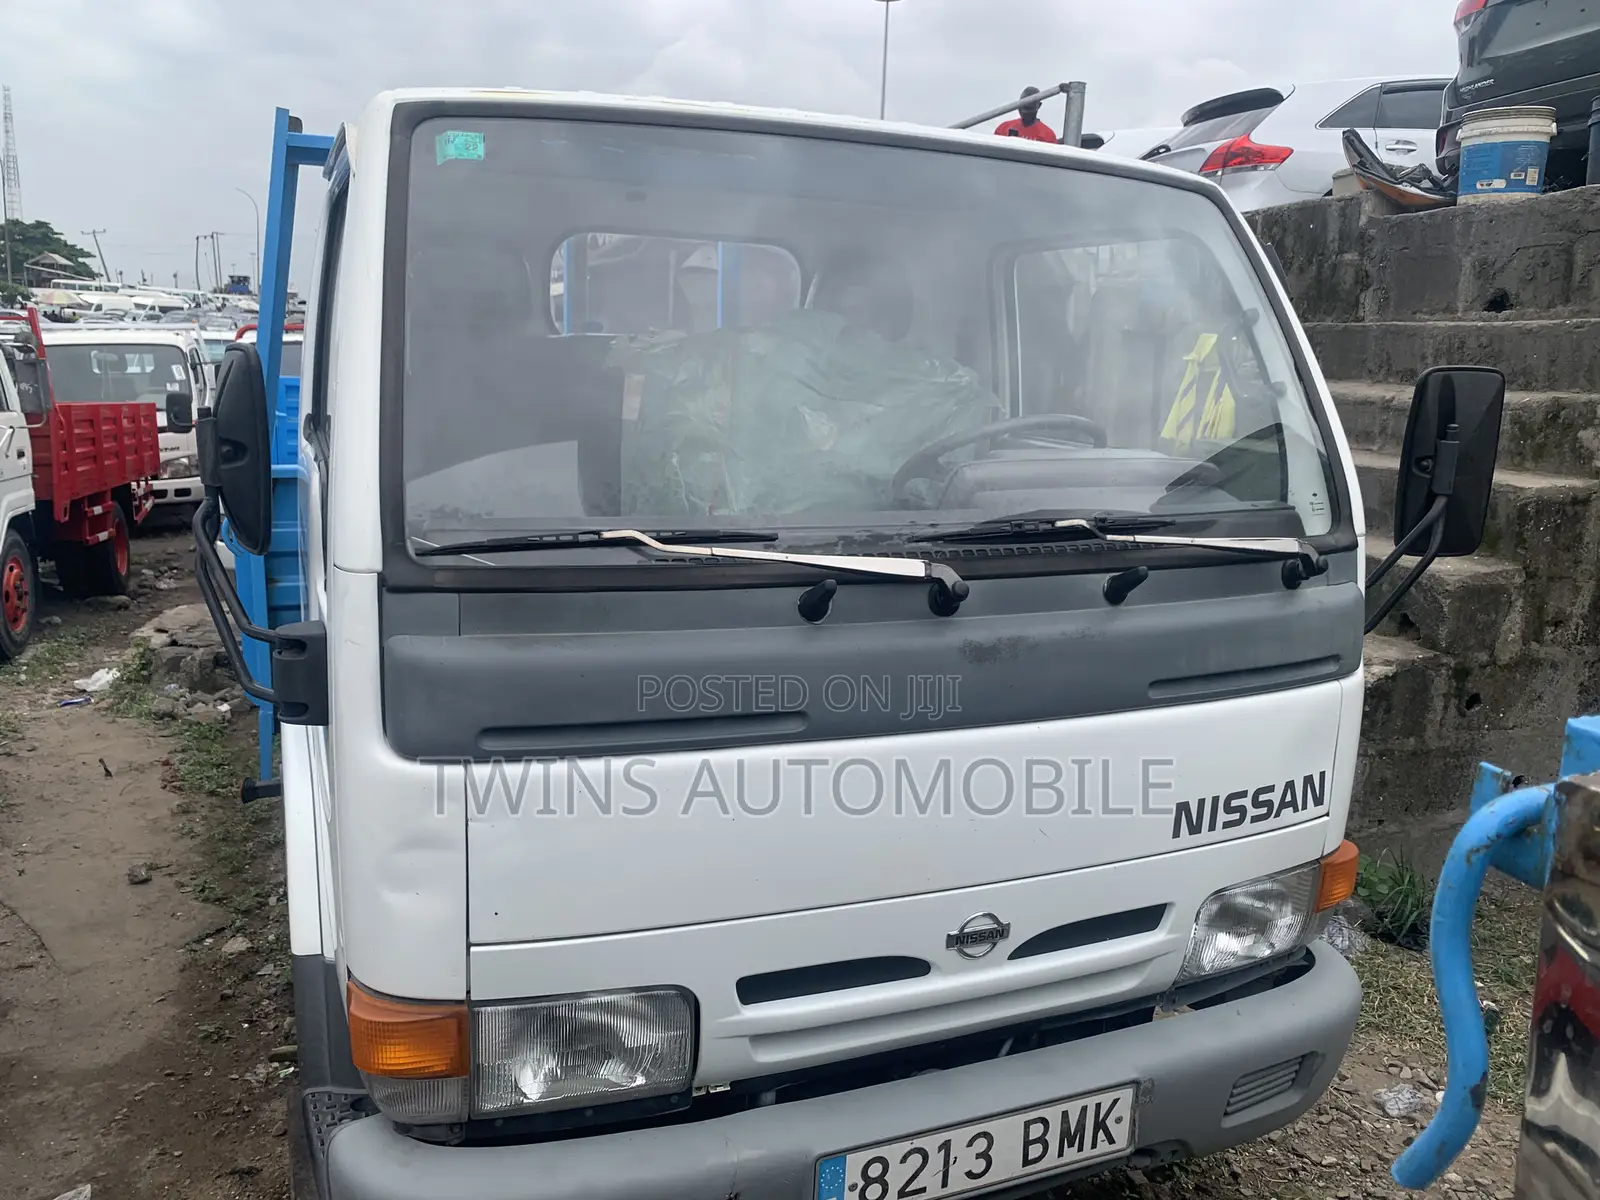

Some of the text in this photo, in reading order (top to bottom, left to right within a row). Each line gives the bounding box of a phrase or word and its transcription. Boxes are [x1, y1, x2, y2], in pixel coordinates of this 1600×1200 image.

[1171, 770, 1327, 839] NISSAN
[955, 928, 1005, 946] NISSAN
[858, 1097, 1121, 1200] 8213 BMK
